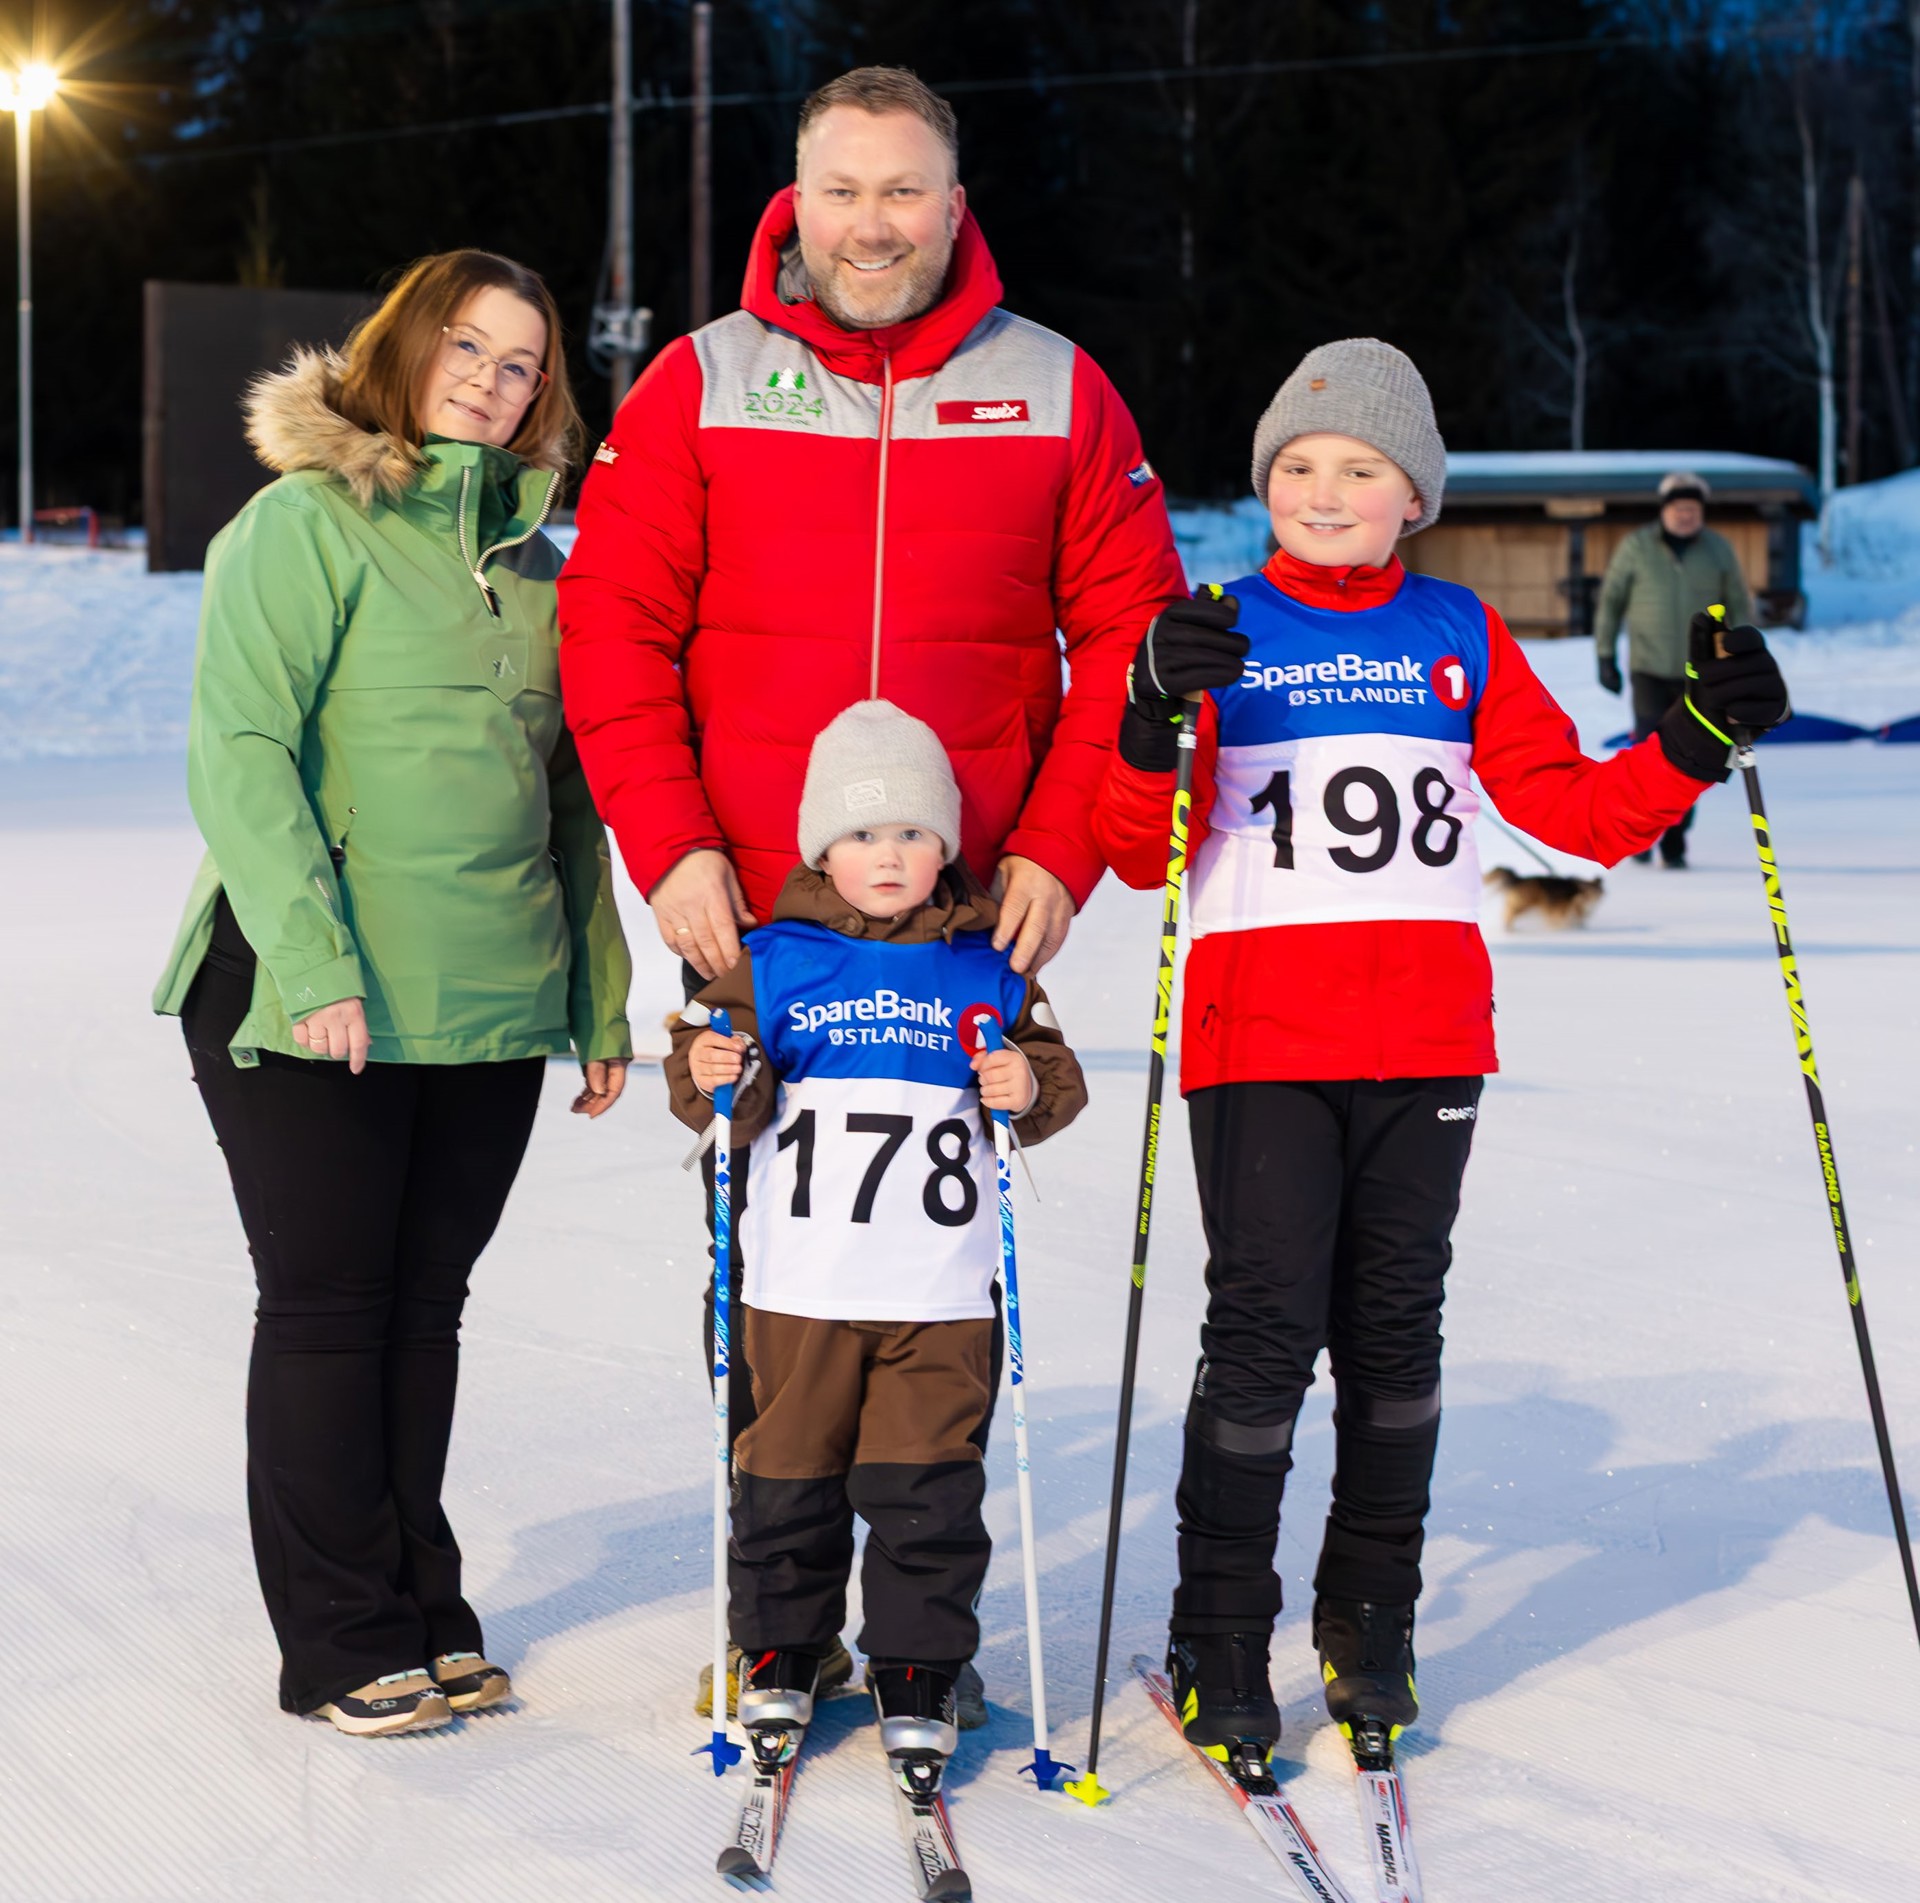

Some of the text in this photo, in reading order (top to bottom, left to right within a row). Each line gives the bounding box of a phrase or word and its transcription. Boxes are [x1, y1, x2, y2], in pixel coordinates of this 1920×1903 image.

[743, 391, 824, 419] 2024
[1241, 653, 1464, 700] SpareBank 1
[1288, 687, 1429, 707] ØSTLANDET
[1249, 765, 1463, 874] 198
[788, 989, 953, 1033] SpareBank
[828, 1026, 953, 1053] ØSTLANDET
[777, 1108, 978, 1228] 178
[1814, 1121, 1841, 1204] DIAMOND
